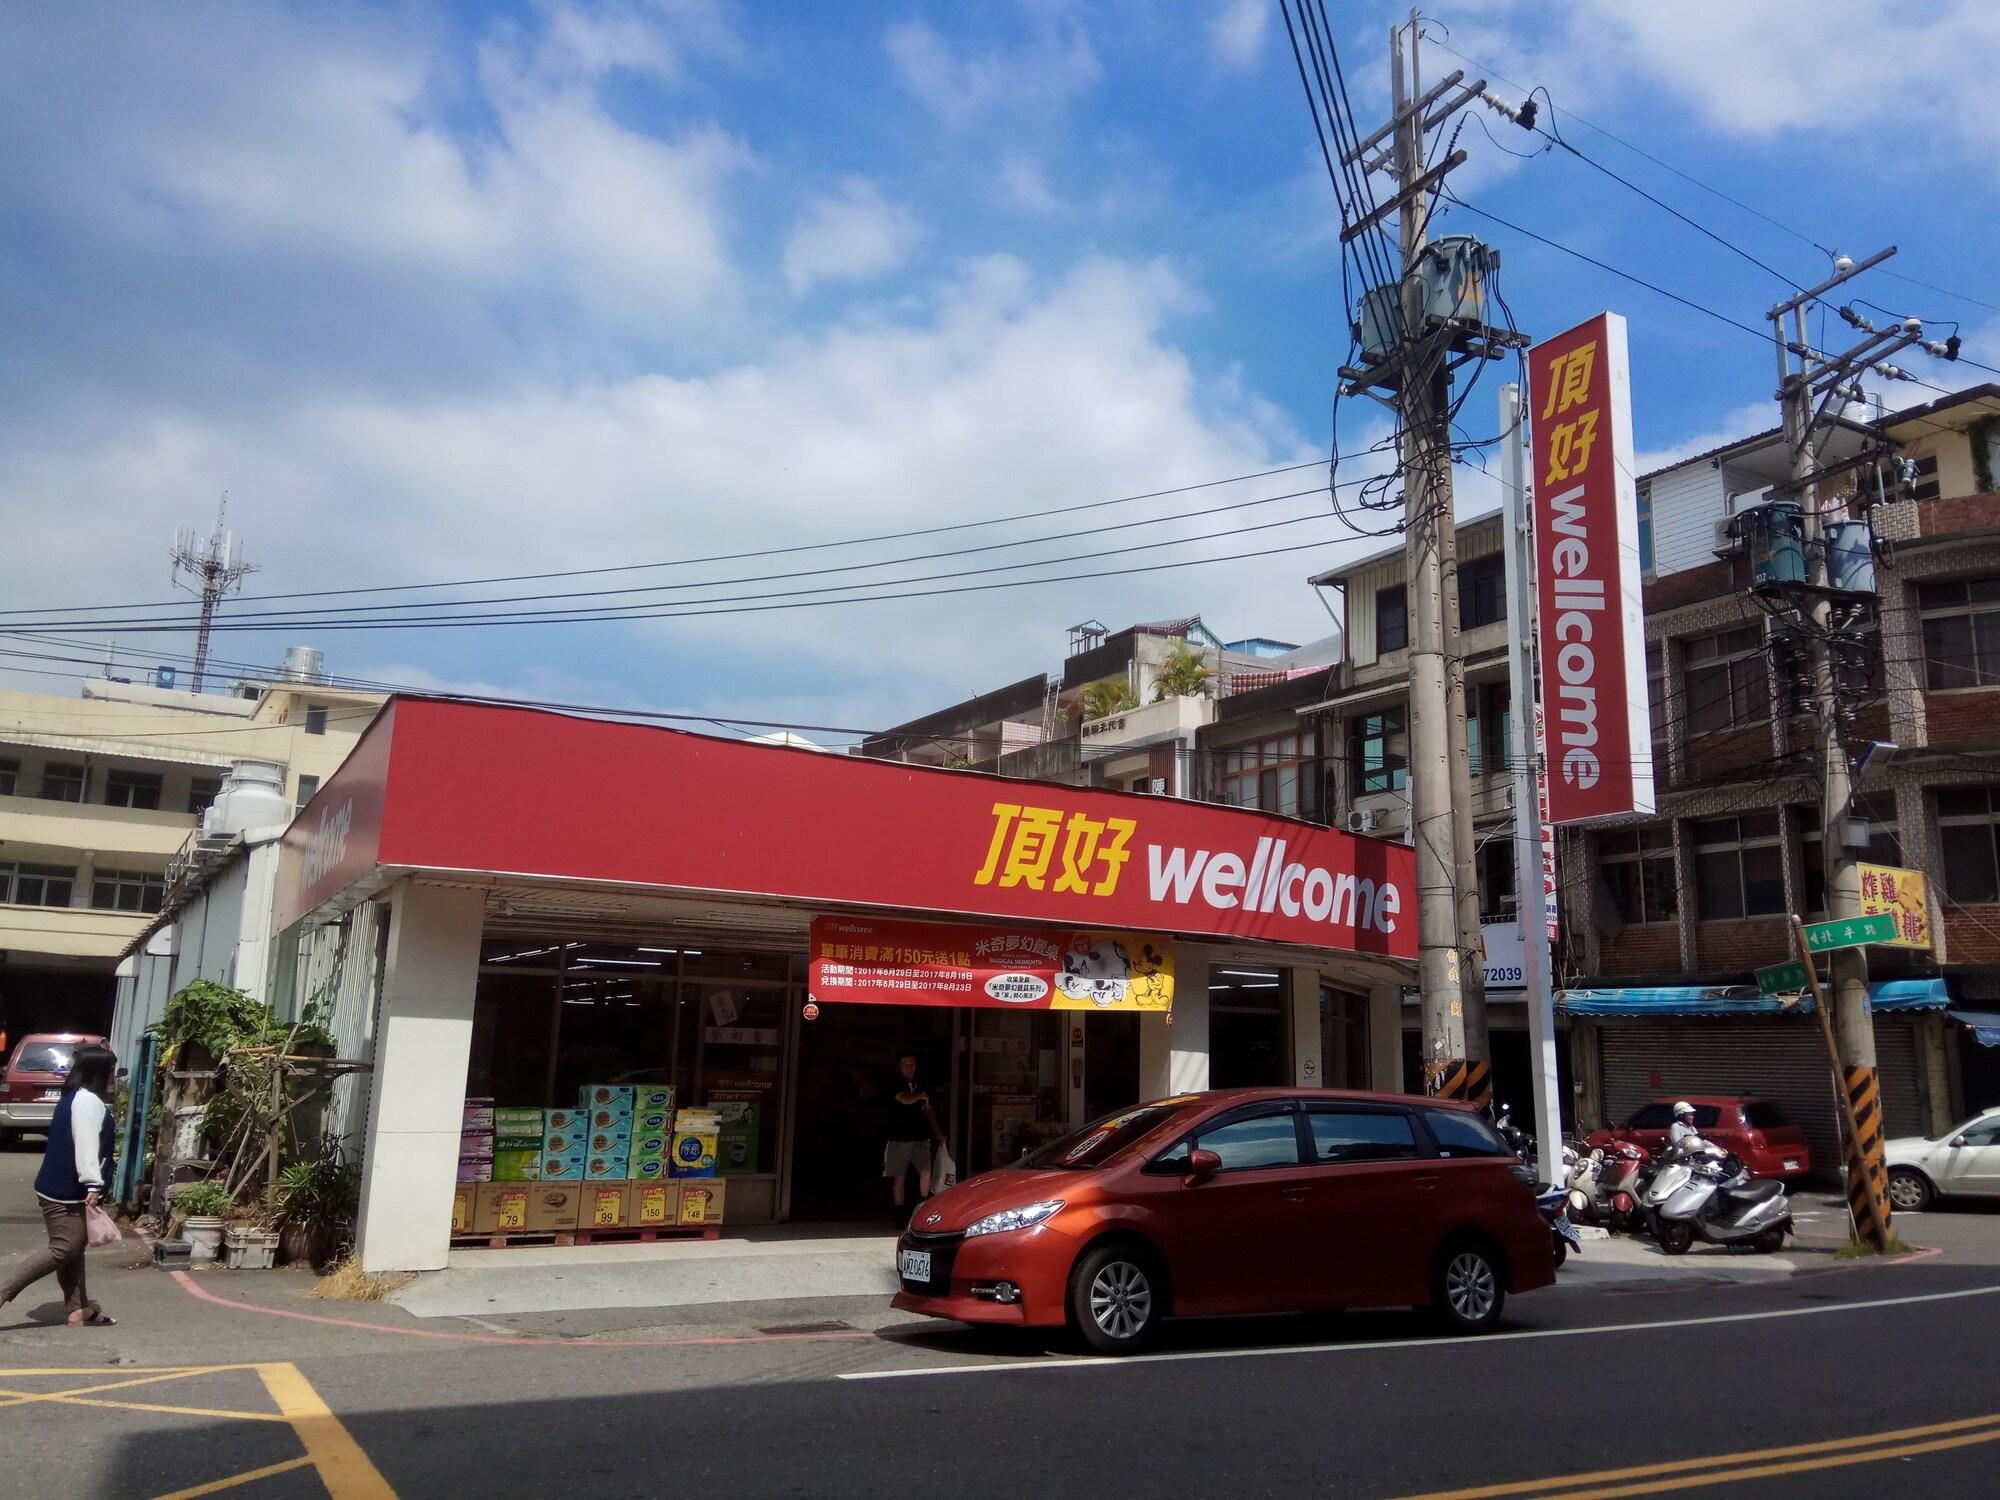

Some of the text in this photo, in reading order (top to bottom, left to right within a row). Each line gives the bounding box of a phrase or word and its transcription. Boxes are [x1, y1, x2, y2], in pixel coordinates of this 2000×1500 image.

[1542, 340, 1600, 486] 頂好
[1550, 483, 1606, 791] wellcome
[974, 802, 1401, 933] 頂好 wellcome
[838, 923, 874, 935] wellcome
[820, 942, 972, 967] 單筆消費滿150元送1點
[975, 935, 1062, 961] 米奇夢幻餐桌
[506, 1215, 518, 1225] 79
[600, 1212, 613, 1223] 99
[646, 1209, 660, 1217] 150
[687, 1210, 700, 1219] 148
